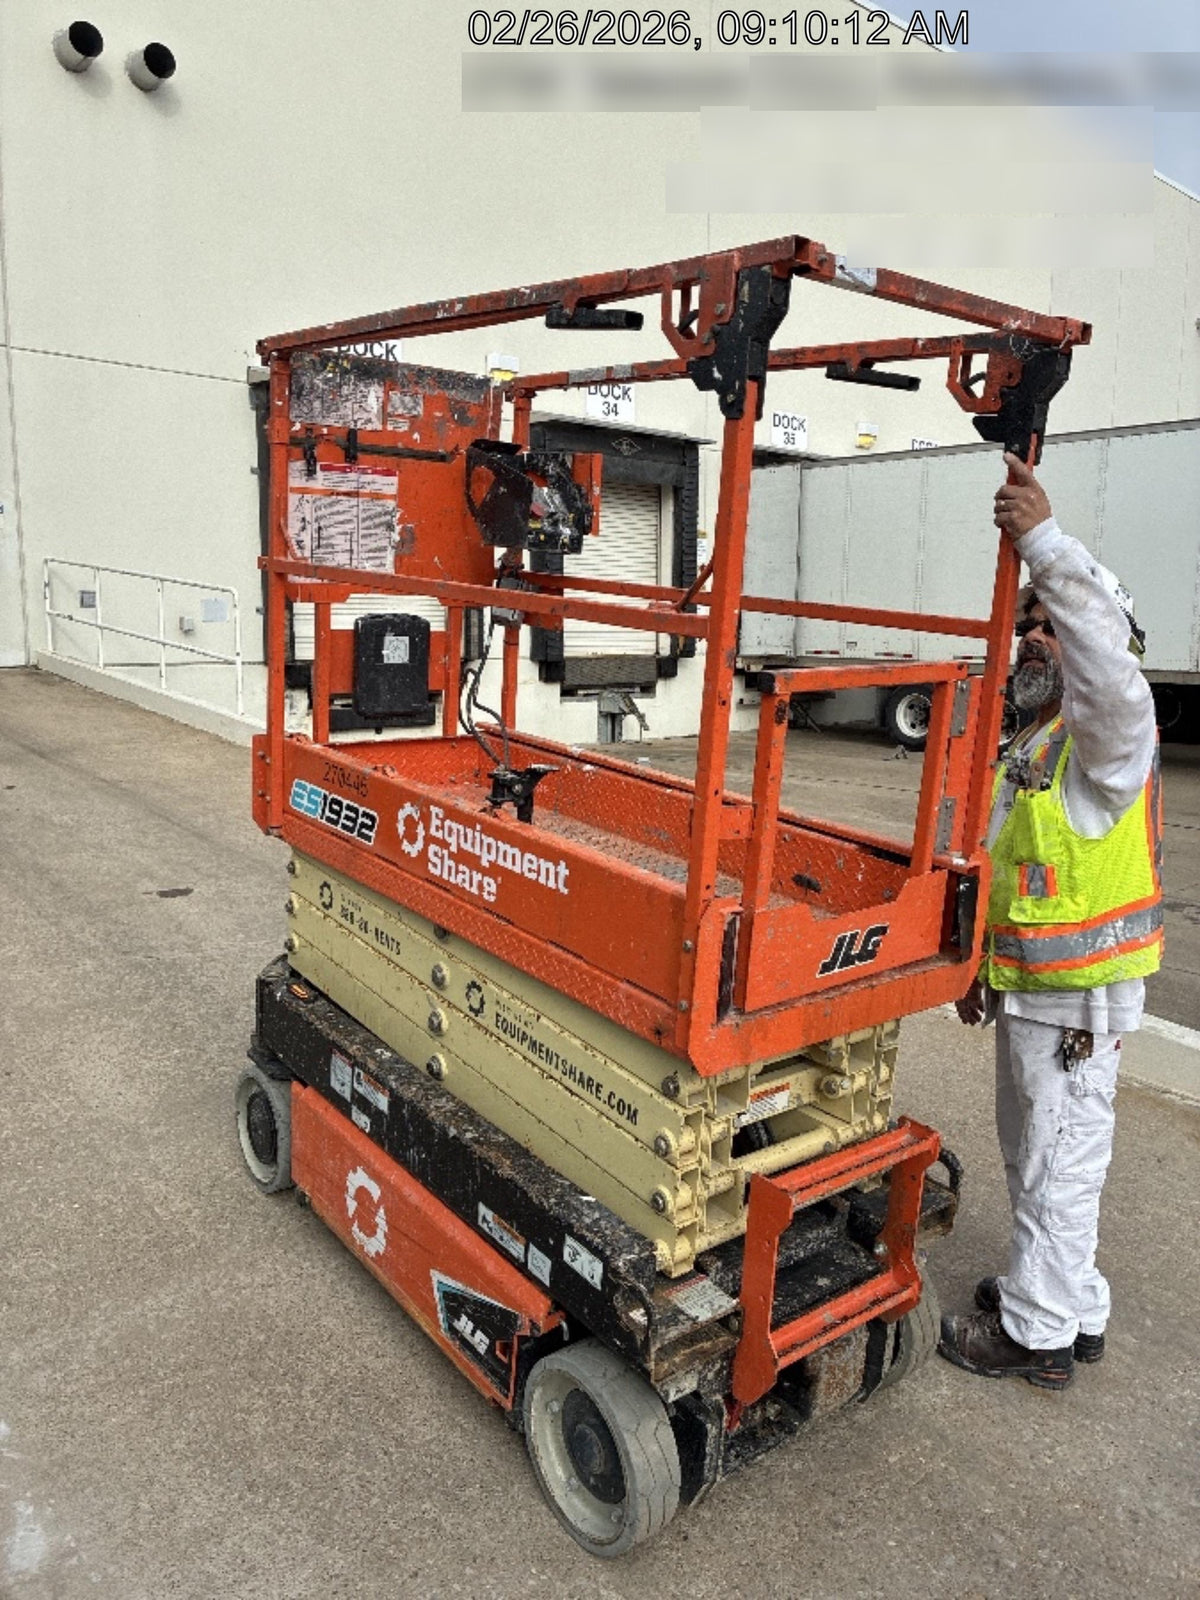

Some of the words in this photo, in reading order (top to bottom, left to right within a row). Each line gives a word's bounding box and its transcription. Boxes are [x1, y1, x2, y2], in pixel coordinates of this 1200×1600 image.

[588, 383, 632, 402] DOCK
[602, 401, 619, 416] 34
[773, 412, 806, 432] DOCK
[290, 779, 378, 845] ES1932
[427, 843, 498, 903] Share
[429, 804, 570, 895] Equipment
[816, 923, 889, 978] JLG
[494, 1011, 639, 1126] EQUIPMENTSHARE.COM
[452, 1313, 490, 1356] JLG
